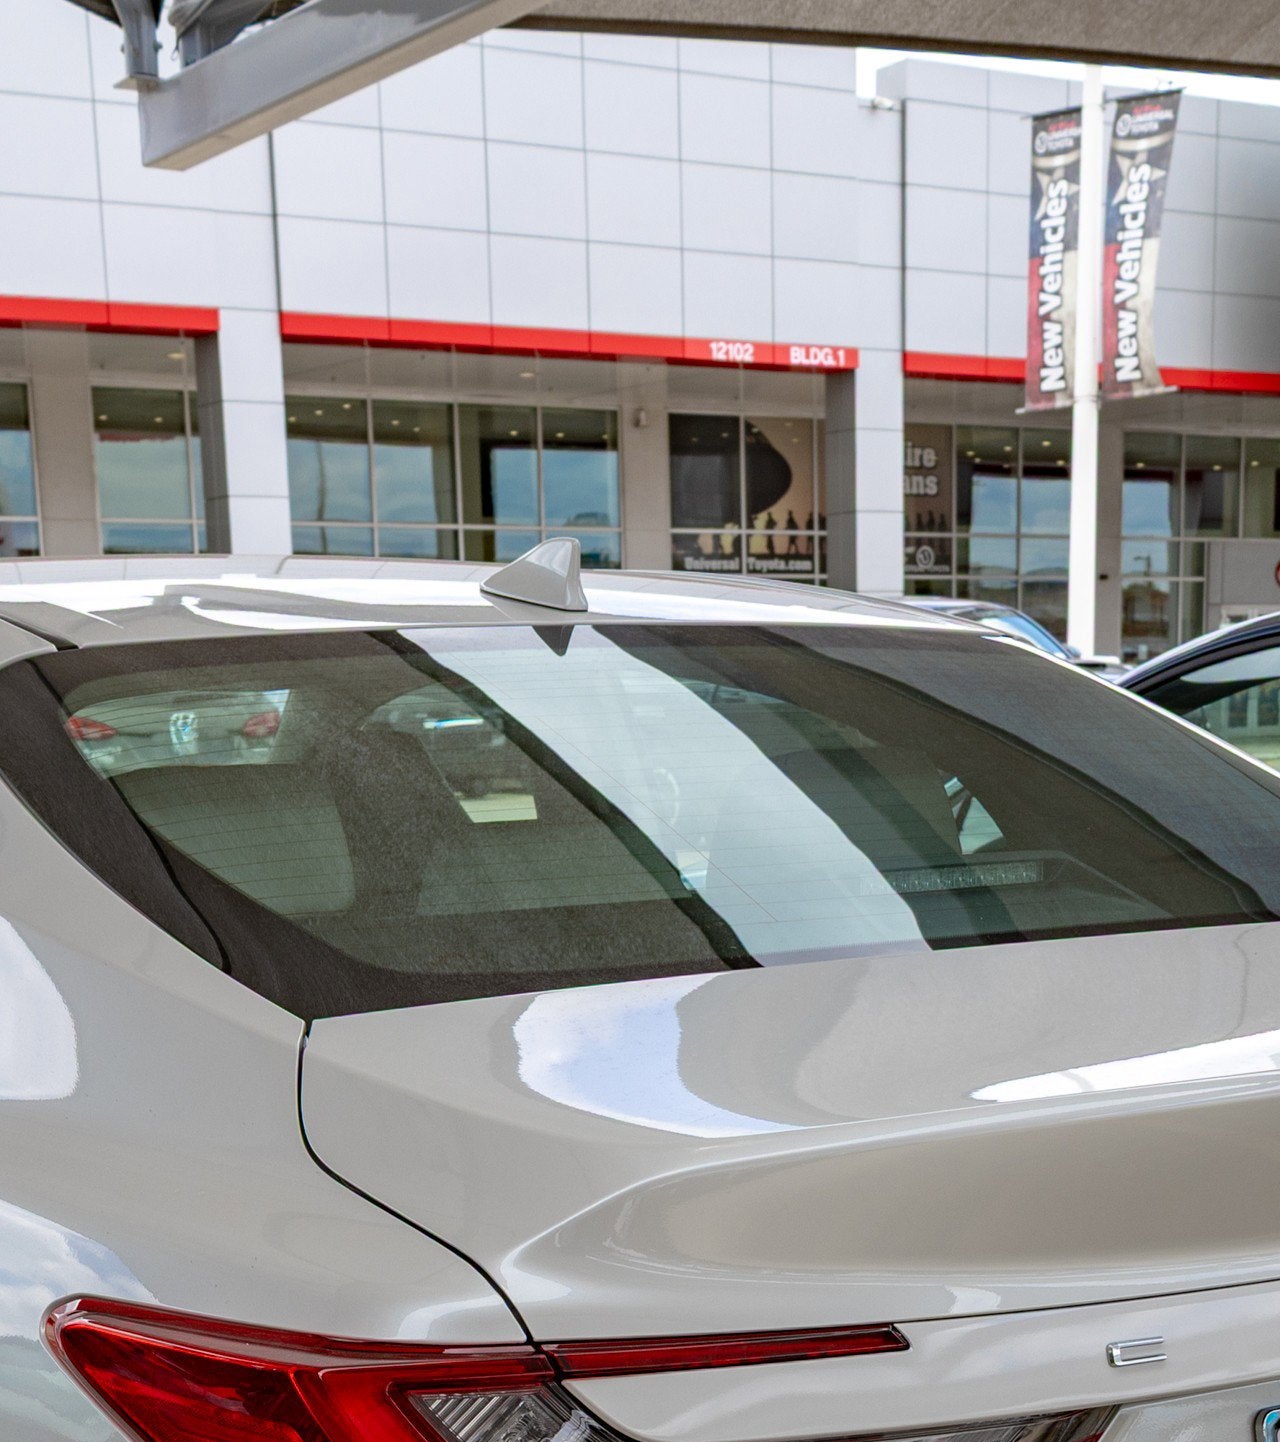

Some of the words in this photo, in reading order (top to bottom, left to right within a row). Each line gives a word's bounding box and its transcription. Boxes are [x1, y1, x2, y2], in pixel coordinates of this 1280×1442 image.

[1038, 178, 1069, 317] Vehicles
[1114, 163, 1152, 304] Vehicles
[709, 341, 754, 362] 12102
[1039, 320, 1066, 393] New
[1116, 311, 1143, 382] New
